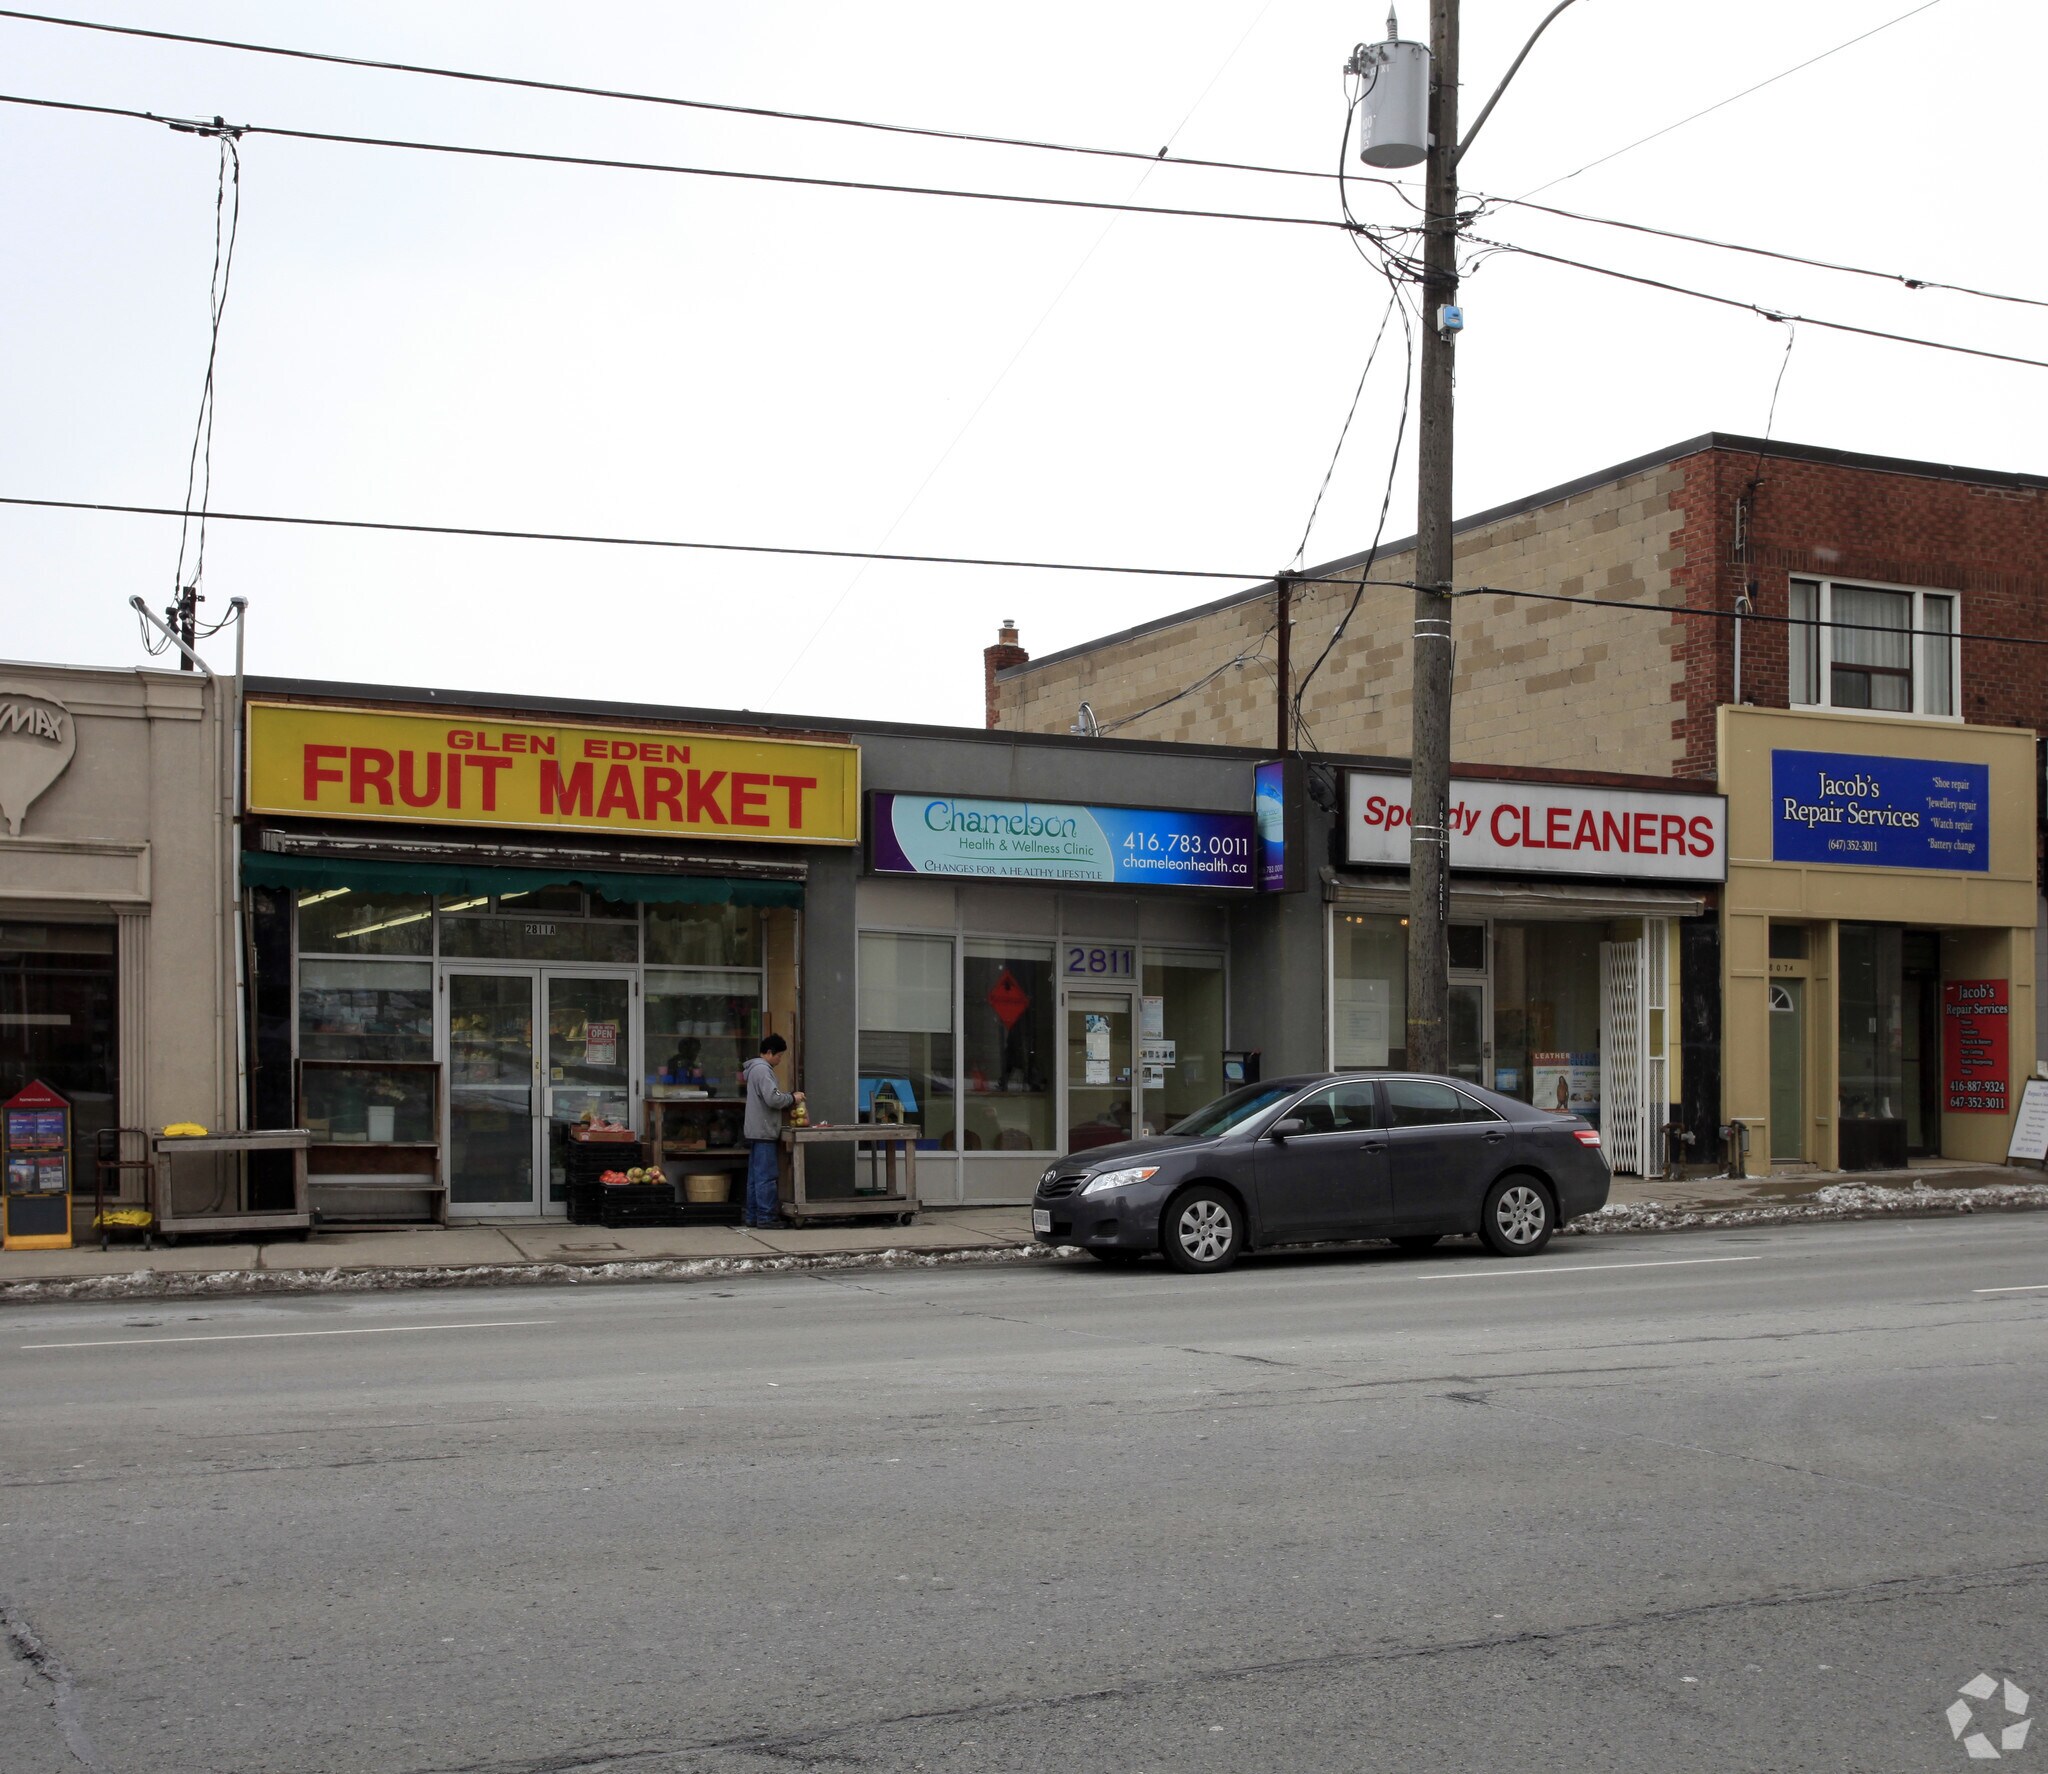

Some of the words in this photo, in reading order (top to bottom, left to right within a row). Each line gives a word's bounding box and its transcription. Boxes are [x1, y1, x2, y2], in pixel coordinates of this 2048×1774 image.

[447, 730, 555, 755] GLEN
[584, 739, 691, 764] EDEN
[303, 743, 513, 812] FRUIT
[540, 759, 817, 829] MARKET
[1818, 772, 1880, 799] Jacob's
[1951, 779, 1970, 793] repair
[1783, 797, 1844, 829] Repair
[1847, 802, 1920, 828] Services
[1958, 800, 1977, 813] repair
[924, 800, 1076, 838] Chameleon
[1954, 820, 1974, 833] repair
[1363, 796, 1482, 836] Spdy
[1490, 804, 1715, 858] CLEANERS
[959, 837, 995, 851] Health
[999, 840, 1008, 851] &
[1011, 840, 1060, 855] Wellness
[1063, 842, 1094, 857] Clinic
[1123, 832, 1248, 856] 416.783.0011
[1828, 839, 1846, 852] (647)
[1846, 840, 1878, 852] 352-3011
[1953, 839, 1976, 854] change
[1123, 853, 1248, 874] chameleonhealth.ca
[976, 865, 996, 875] FOR
[1000, 867, 1007, 875] A
[1009, 867, 1054, 878] HEALTHY
[1056, 869, 1103, 880] LIFESTYLE
[526, 924, 555, 935] 2811A
[1069, 948, 1130, 974] 2811
[1959, 984, 1995, 1000] Jacob's
[1946, 1003, 1972, 1017] Repair
[1974, 1003, 2008, 1015] Services
[591, 1029, 613, 1039] OPEN
[1950, 1081, 2005, 1093] 416-887-9324
[1950, 1097, 2005, 1109] 647-352-3011
